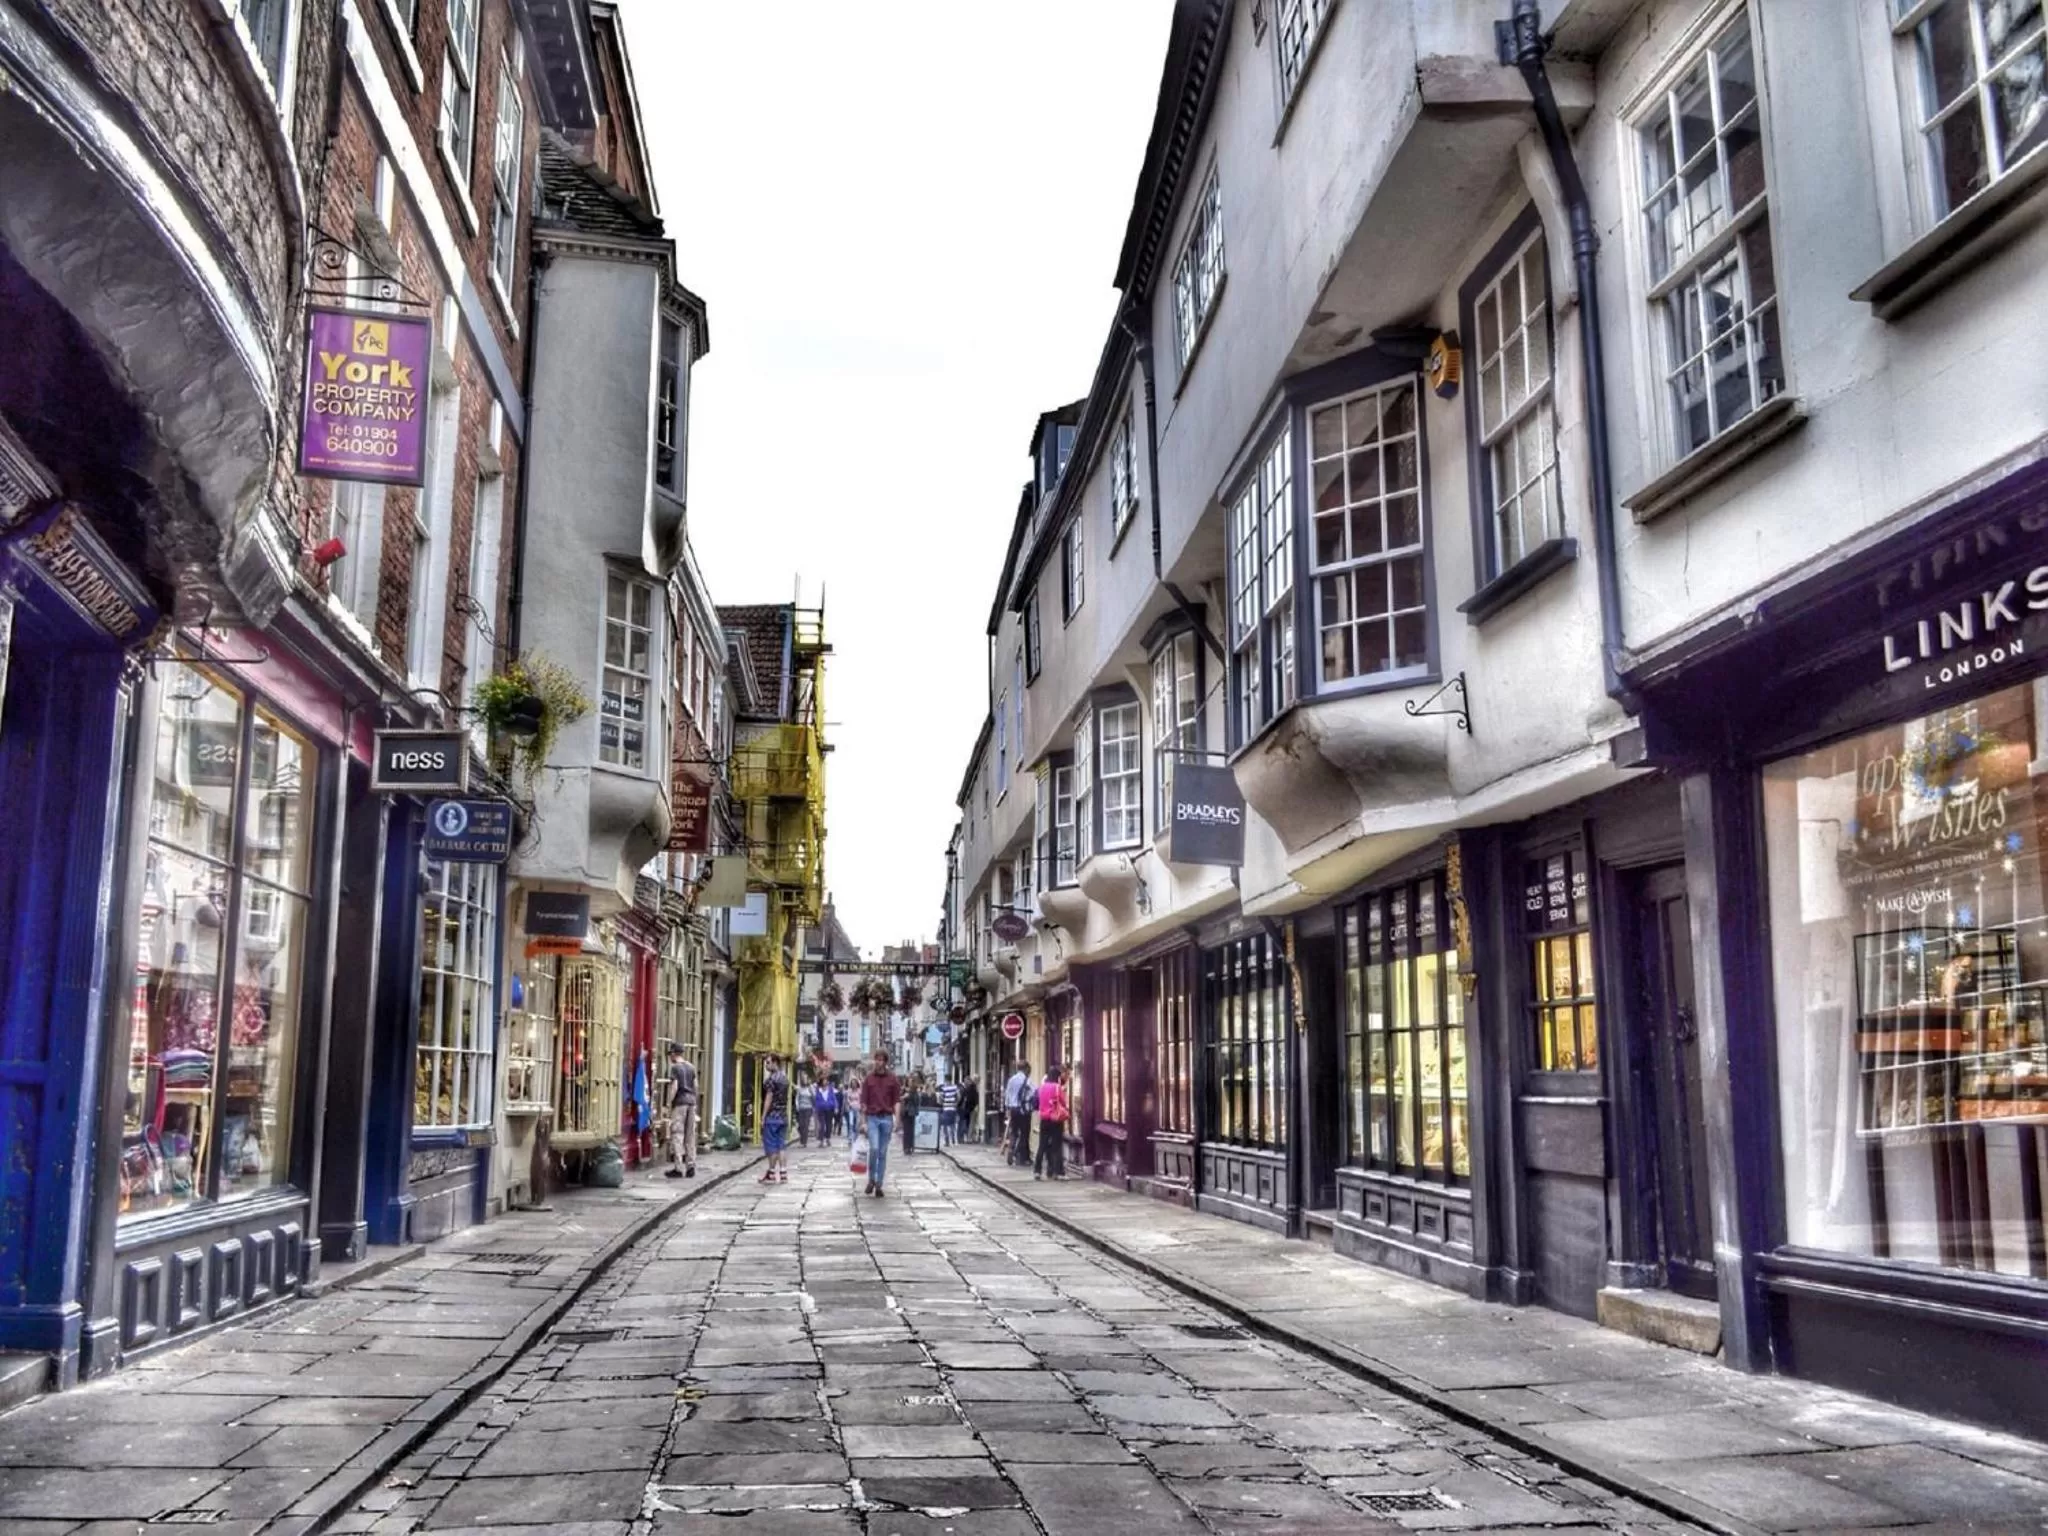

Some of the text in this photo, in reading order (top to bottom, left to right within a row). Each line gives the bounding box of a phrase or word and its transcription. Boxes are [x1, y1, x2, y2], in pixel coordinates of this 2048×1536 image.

[319, 352, 413, 388] York
[313, 383, 416, 405] PROPERTY
[313, 399, 414, 421] COMPANY
[352, 425, 398, 440] 01904
[326, 437, 398, 456] 640900
[1883, 565, 2048, 672] LINKS
[1924, 639, 2024, 688] LONDON
[391, 751, 446, 769] ness
[674, 782, 693, 793] The
[672, 793, 707, 807] tiques
[672, 807, 699, 819] entre
[1177, 803, 1240, 825] BRADLEYS
